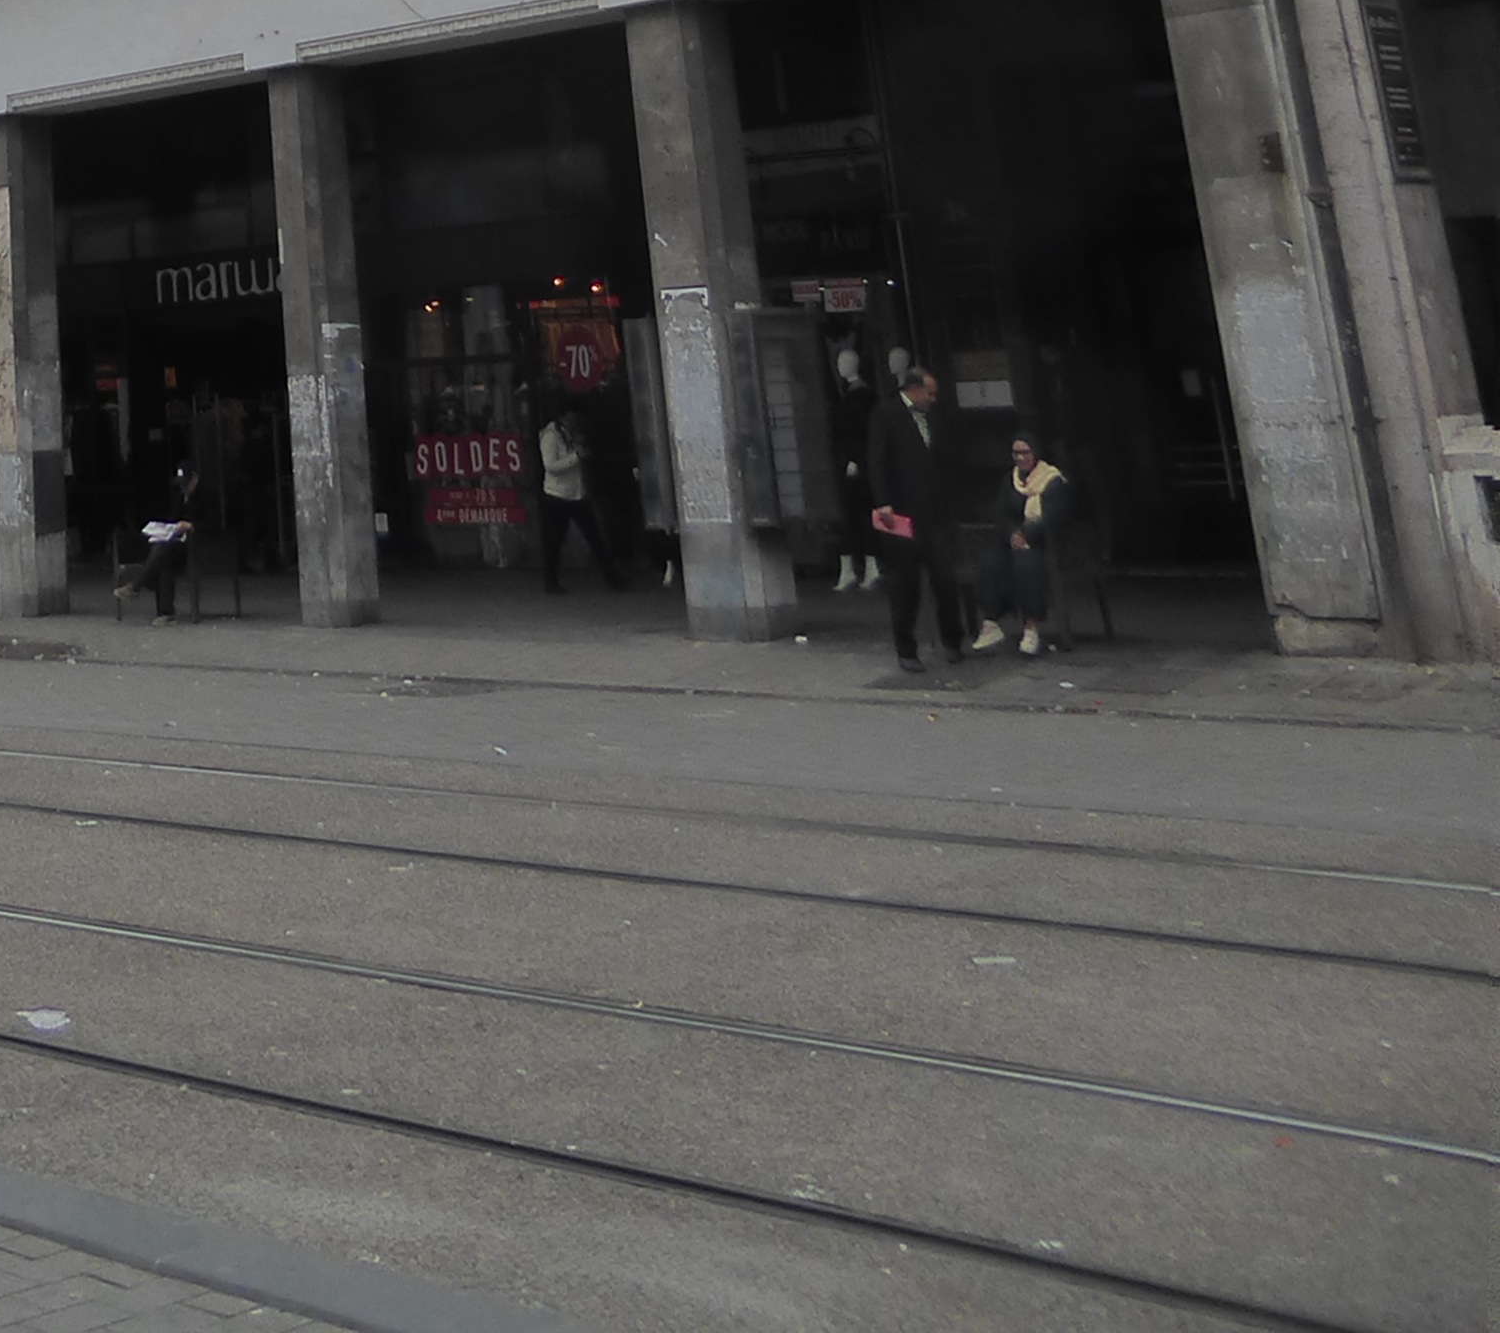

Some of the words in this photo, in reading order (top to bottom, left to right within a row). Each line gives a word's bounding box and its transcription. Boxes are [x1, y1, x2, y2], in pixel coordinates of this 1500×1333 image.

[156, 257, 281, 304] marw
[559, 343, 598, 379] -70%
[416, 437, 521, 475] SOLDES
